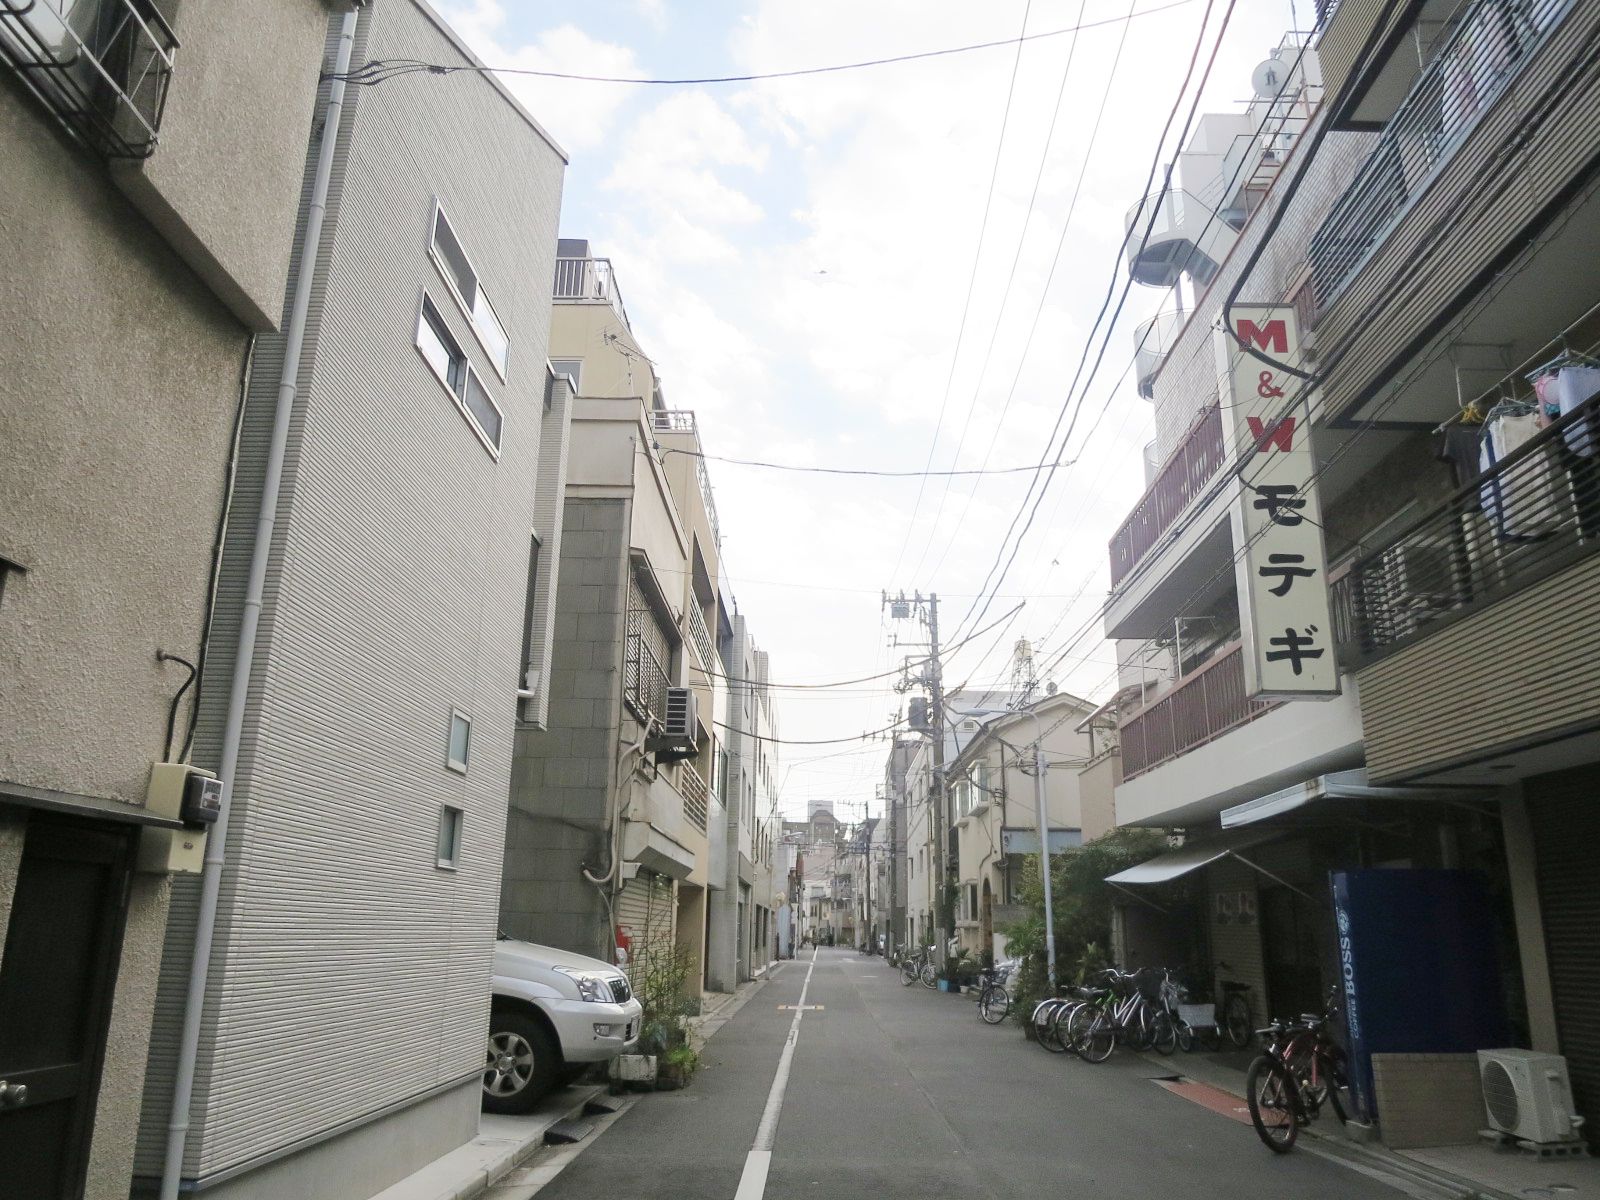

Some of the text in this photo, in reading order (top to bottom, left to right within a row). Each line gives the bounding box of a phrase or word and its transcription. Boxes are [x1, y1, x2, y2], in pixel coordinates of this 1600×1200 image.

[1253, 484, 1325, 676] モテギ
[1340, 936, 1355, 995] BOSS
